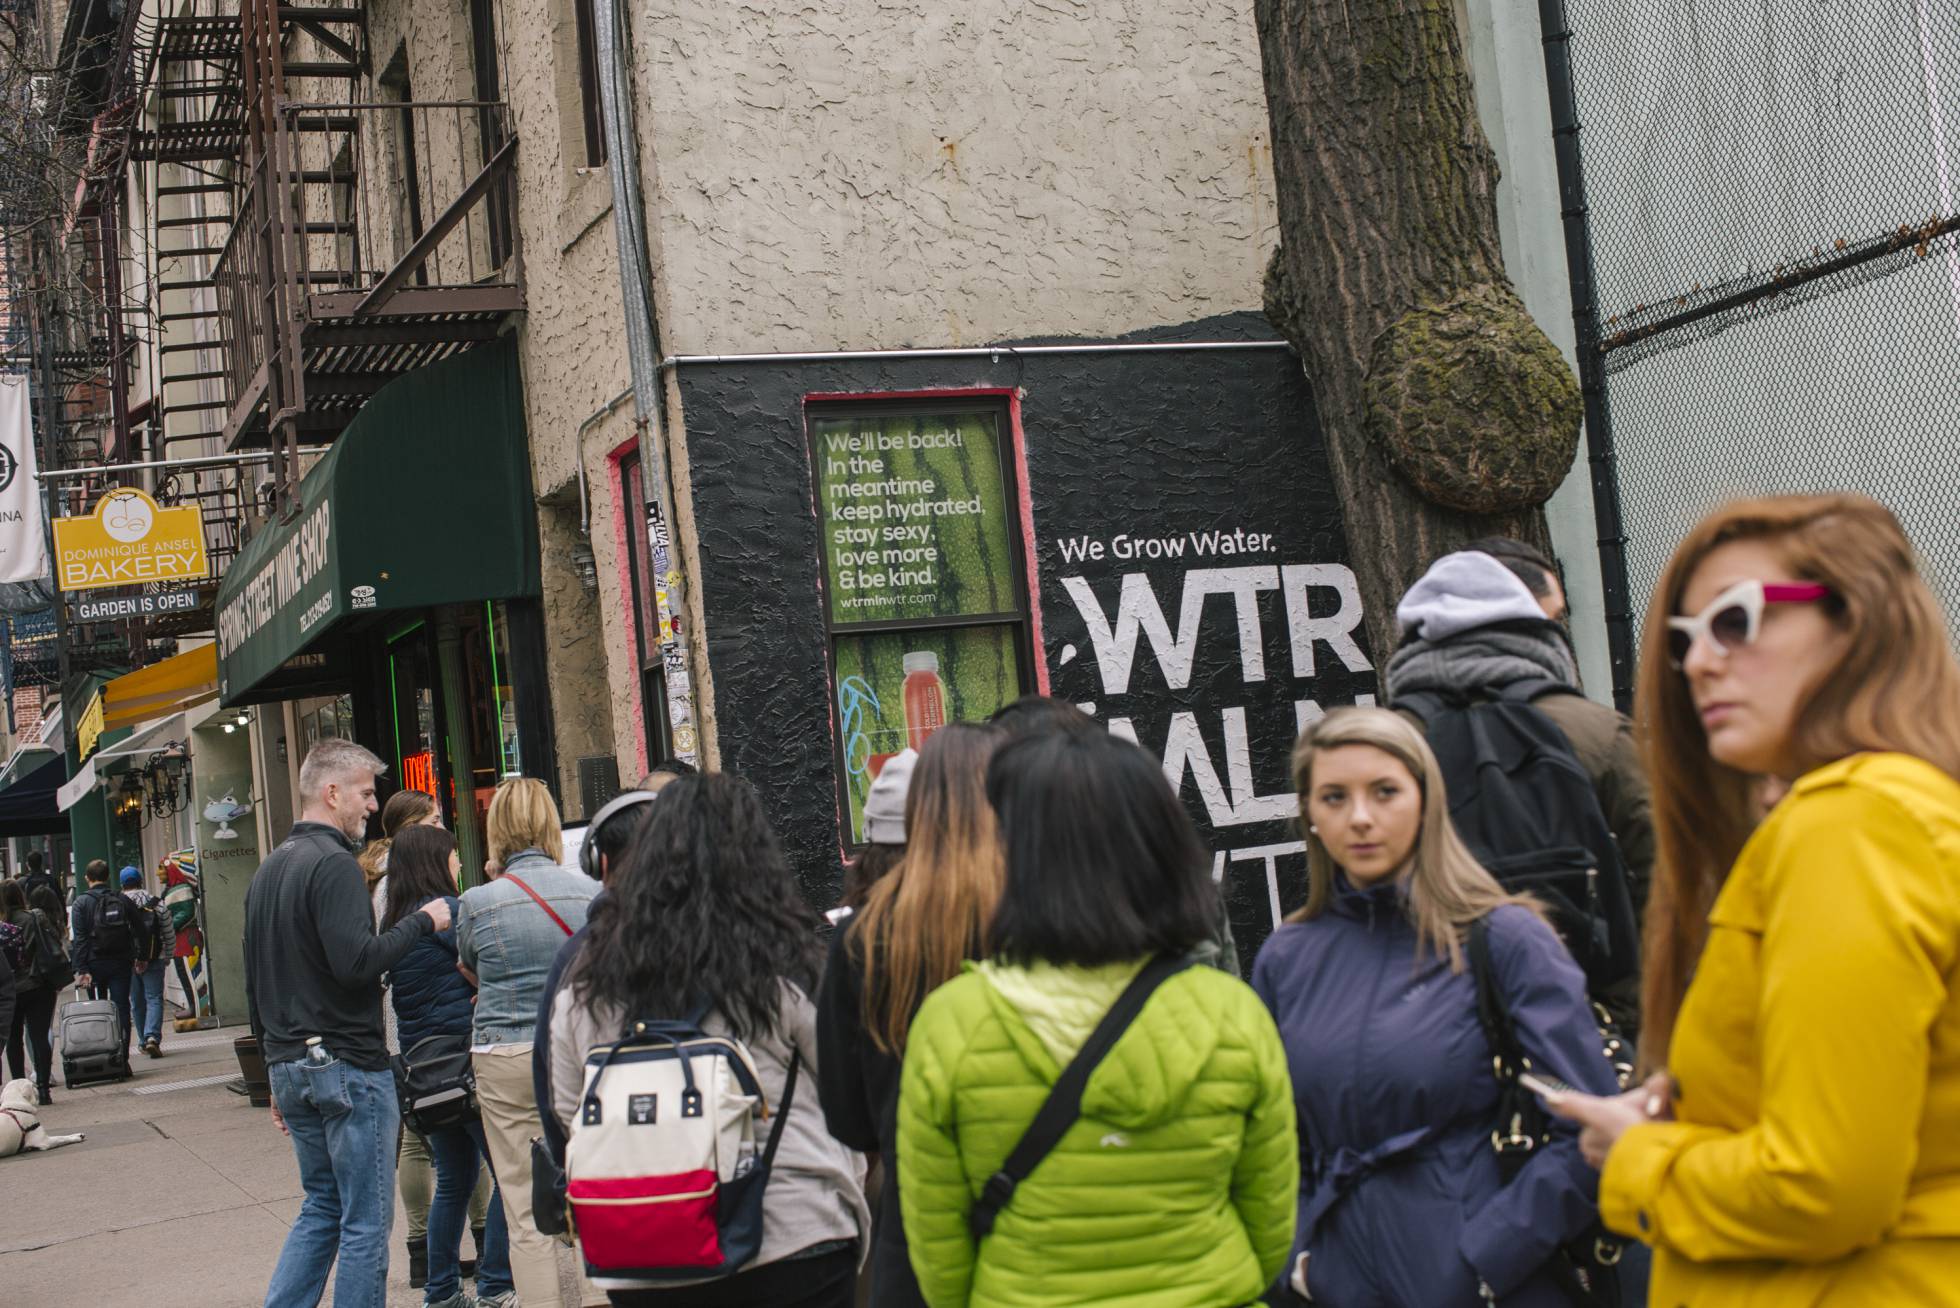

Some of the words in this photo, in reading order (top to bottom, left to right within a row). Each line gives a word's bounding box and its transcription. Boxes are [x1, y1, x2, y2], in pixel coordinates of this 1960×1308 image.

[825, 431, 873, 451] We'll
[878, 431, 904, 449] be
[908, 428, 962, 449] back!
[827, 457, 846, 475] In
[849, 455, 884, 474] the
[829, 477, 935, 498] meantime
[831, 503, 883, 524] keep
[834, 527, 879, 547] stay
[882, 524, 936, 544] sexy,
[1057, 536, 1104, 563] We
[1111, 532, 1186, 559] Grow
[1189, 526, 1278, 555] Water.
[64, 543, 149, 562] DOMINIQUE
[154, 538, 198, 553] ANSEL
[836, 548, 879, 567] love
[882, 547, 938, 564] more
[66, 552, 198, 584] BAKERY
[839, 571, 856, 590] &
[858, 570, 886, 589] be
[888, 566, 937, 586] kind.
[219, 591, 246, 661] SPRING
[245, 559, 276, 638] STREET
[275, 531, 302, 611] WINE
[301, 499, 330, 585] SHOP
[79, 600, 136, 618] GARDEN
[140, 598, 153, 612] IS
[158, 593, 194, 610] OPEN
[840, 594, 936, 608] wtrmlnwtr.com
[1060, 563, 1375, 696] WTR
[202, 847, 257, 860] Cigarettes
